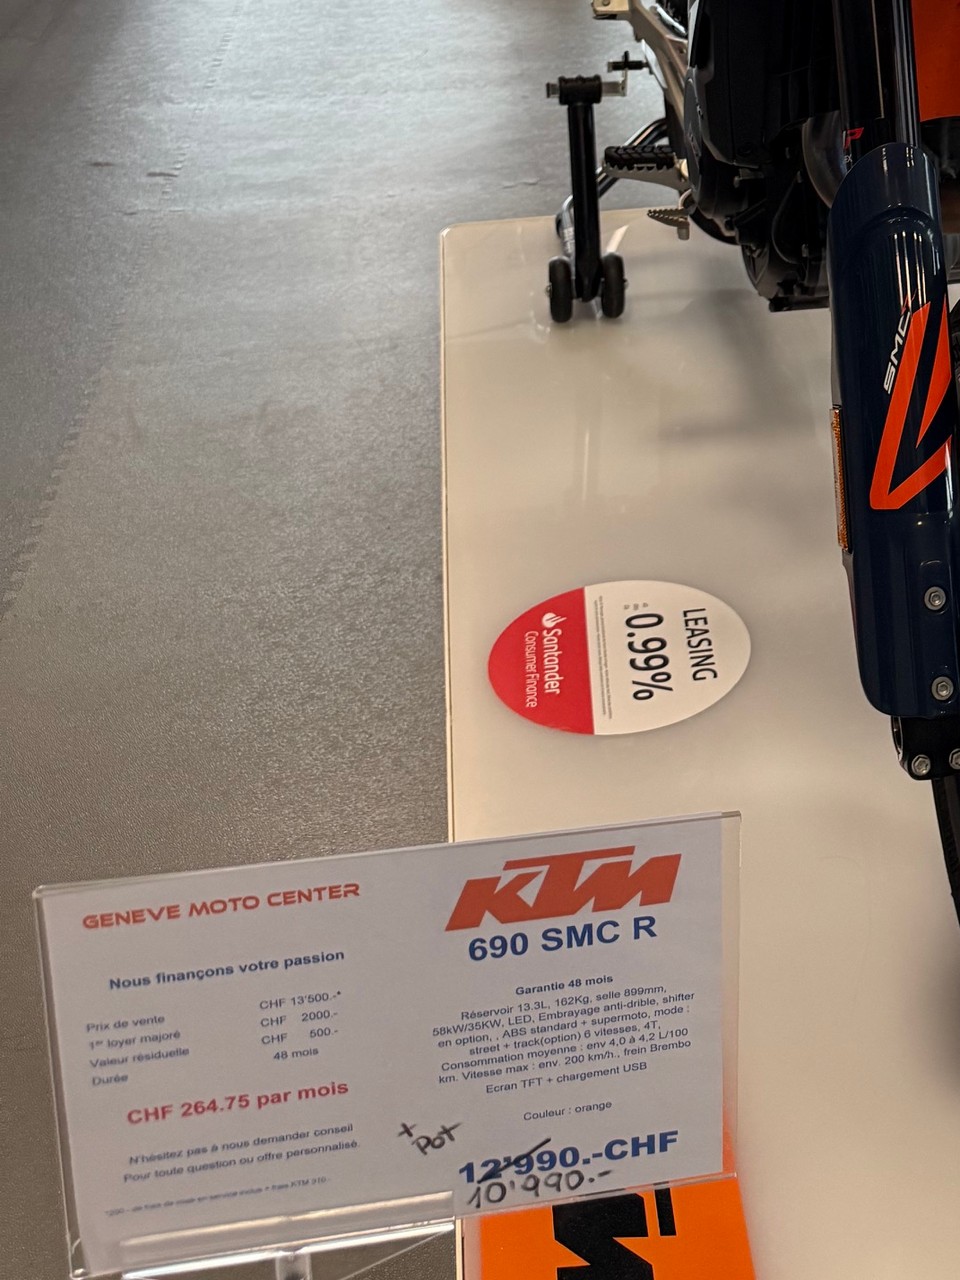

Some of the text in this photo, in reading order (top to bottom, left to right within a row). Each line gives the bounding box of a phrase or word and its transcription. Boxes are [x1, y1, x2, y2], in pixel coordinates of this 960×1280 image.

[883, 311, 910, 395] SMC
[542, 627, 561, 696] Santander
[625, 613, 674, 701] 0.99%
[682, 607, 718, 682] LEASING
[524, 630, 539, 708] Consumer Finance
[82, 883, 361, 930] GENEVE MOTO CENTER
[444, 845, 682, 932] KTM
[468, 915, 658, 961] 690 SMC R
[109, 951, 345, 990] Nous finançons votre passion
[515, 975, 614, 996] Garantie 48 mois
[259, 998, 286, 1011] CHF
[260, 1009, 338, 1028] CHF 2000.-
[460, 985, 667, 1021] Réservoir 13.3L, 162Kg, selle 899mm,
[508, 1014, 535, 1026] LED,
[538, 1005, 600, 1022] Embrayage
[603, 998, 659, 1013] anti-drible,
[662, 992, 695, 1004] shifter
[86, 1014, 165, 1033] Prix de vente
[107, 1036, 137, 1051] loyer
[140, 1029, 181, 1046] majoré
[261, 1026, 338, 1045] CHF 500.-
[437, 1039, 452, 1048] en
[455, 1033, 492, 1047] option,
[502, 1027, 527, 1039] ABS
[530, 1020, 578, 1035] standard
[591, 1011, 651, 1027] supermoto,
[654, 1005, 684, 1017] mode
[469, 1043, 500, 1056] street
[513, 1031, 581, 1050] track(option)
[583, 1029, 591, 1039] 6
[594, 1025, 641, 1038] vitesses,
[643, 1020, 661, 1031] 4T,
[89, 1047, 190, 1069] Valeur résiduelle
[273, 1046, 319, 1061] 48 mois
[438, 1075, 458, 1084] km.
[461, 1068, 502, 1081] Vitesse
[505, 1064, 529, 1074] max
[538, 1059, 561, 1069] env.
[564, 1054, 585, 1065] 200
[623, 1046, 647, 1057] frein
[650, 1040, 692, 1053] Brembo
[441, 1052, 524, 1072] Consommation
[527, 1044, 577, 1060] moyenne
[586, 1041, 606, 1050] env
[629, 1035, 636, 1044] à
[658, 1027, 689, 1040] L/100
[91, 1073, 129, 1087] Durée
[485, 1081, 518, 1094] Ecran
[521, 1076, 543, 1089] TFT
[556, 1066, 620, 1083] chargement
[623, 1061, 648, 1073] USB
[127, 1080, 349, 1125] CHF 264.75 par mois
[523, 1107, 566, 1121] Couleur
[574, 1100, 613, 1114] orange
[129, 1149, 184, 1166] N'hésitez
[186, 1145, 208, 1158] pas
[221, 1140, 250, 1152] nous
[253, 1130, 310, 1148] demander
[313, 1123, 354, 1138] conseil
[122, 1170, 151, 1183] Pour
[154, 1166, 184, 1179] toute
[187, 1158, 237, 1175] question
[239, 1155, 254, 1166] ou
[256, 1150, 283, 1164] offre
